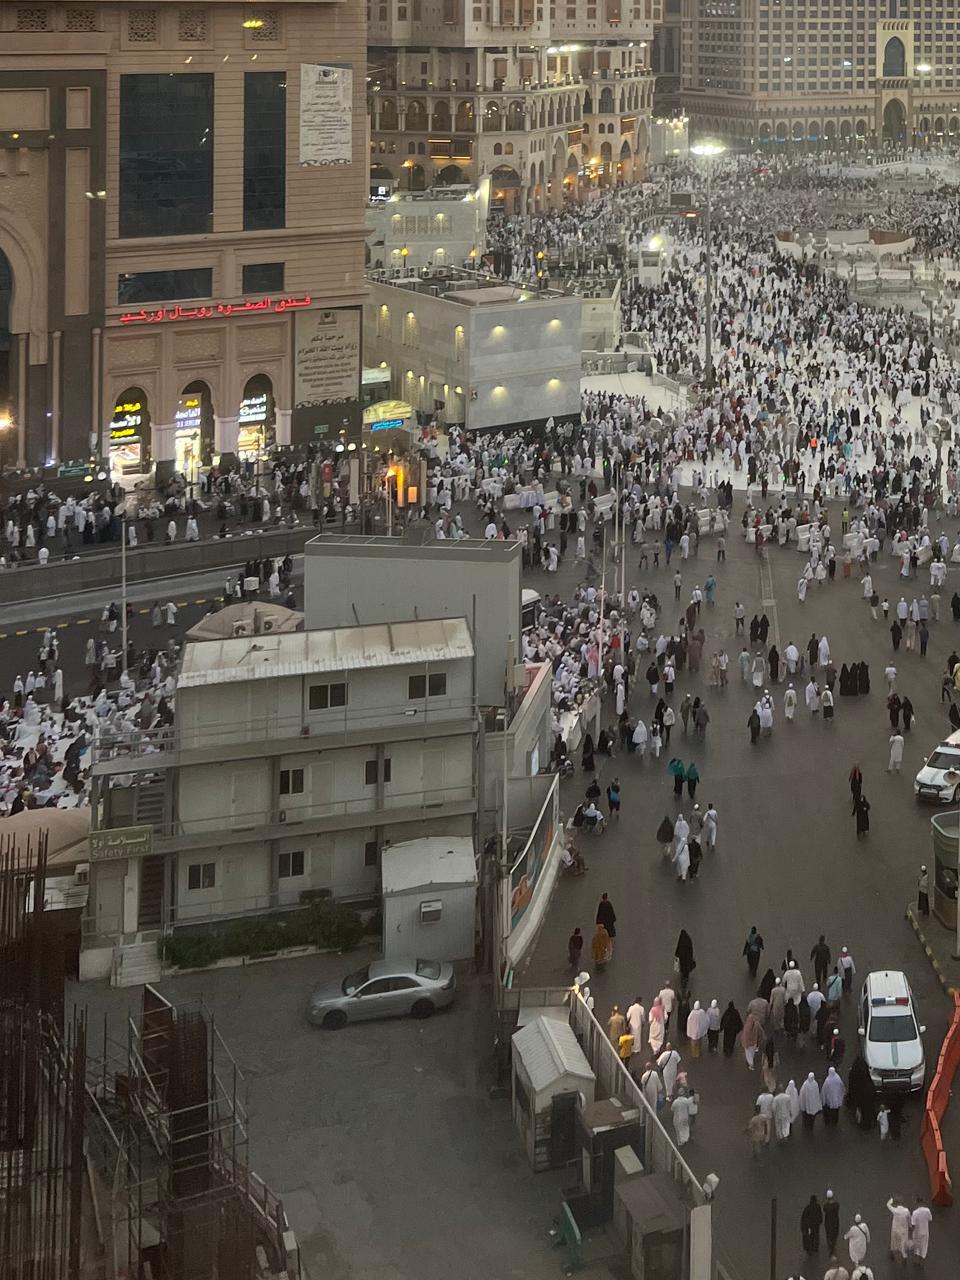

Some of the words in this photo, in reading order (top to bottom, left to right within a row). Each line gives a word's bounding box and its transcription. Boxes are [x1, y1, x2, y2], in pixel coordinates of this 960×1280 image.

[217, 296, 271, 316] الصفوة
[274, 294, 311, 312] فندق
[169, 304, 214, 320] رويال
[92, 847, 124, 858] Safety
